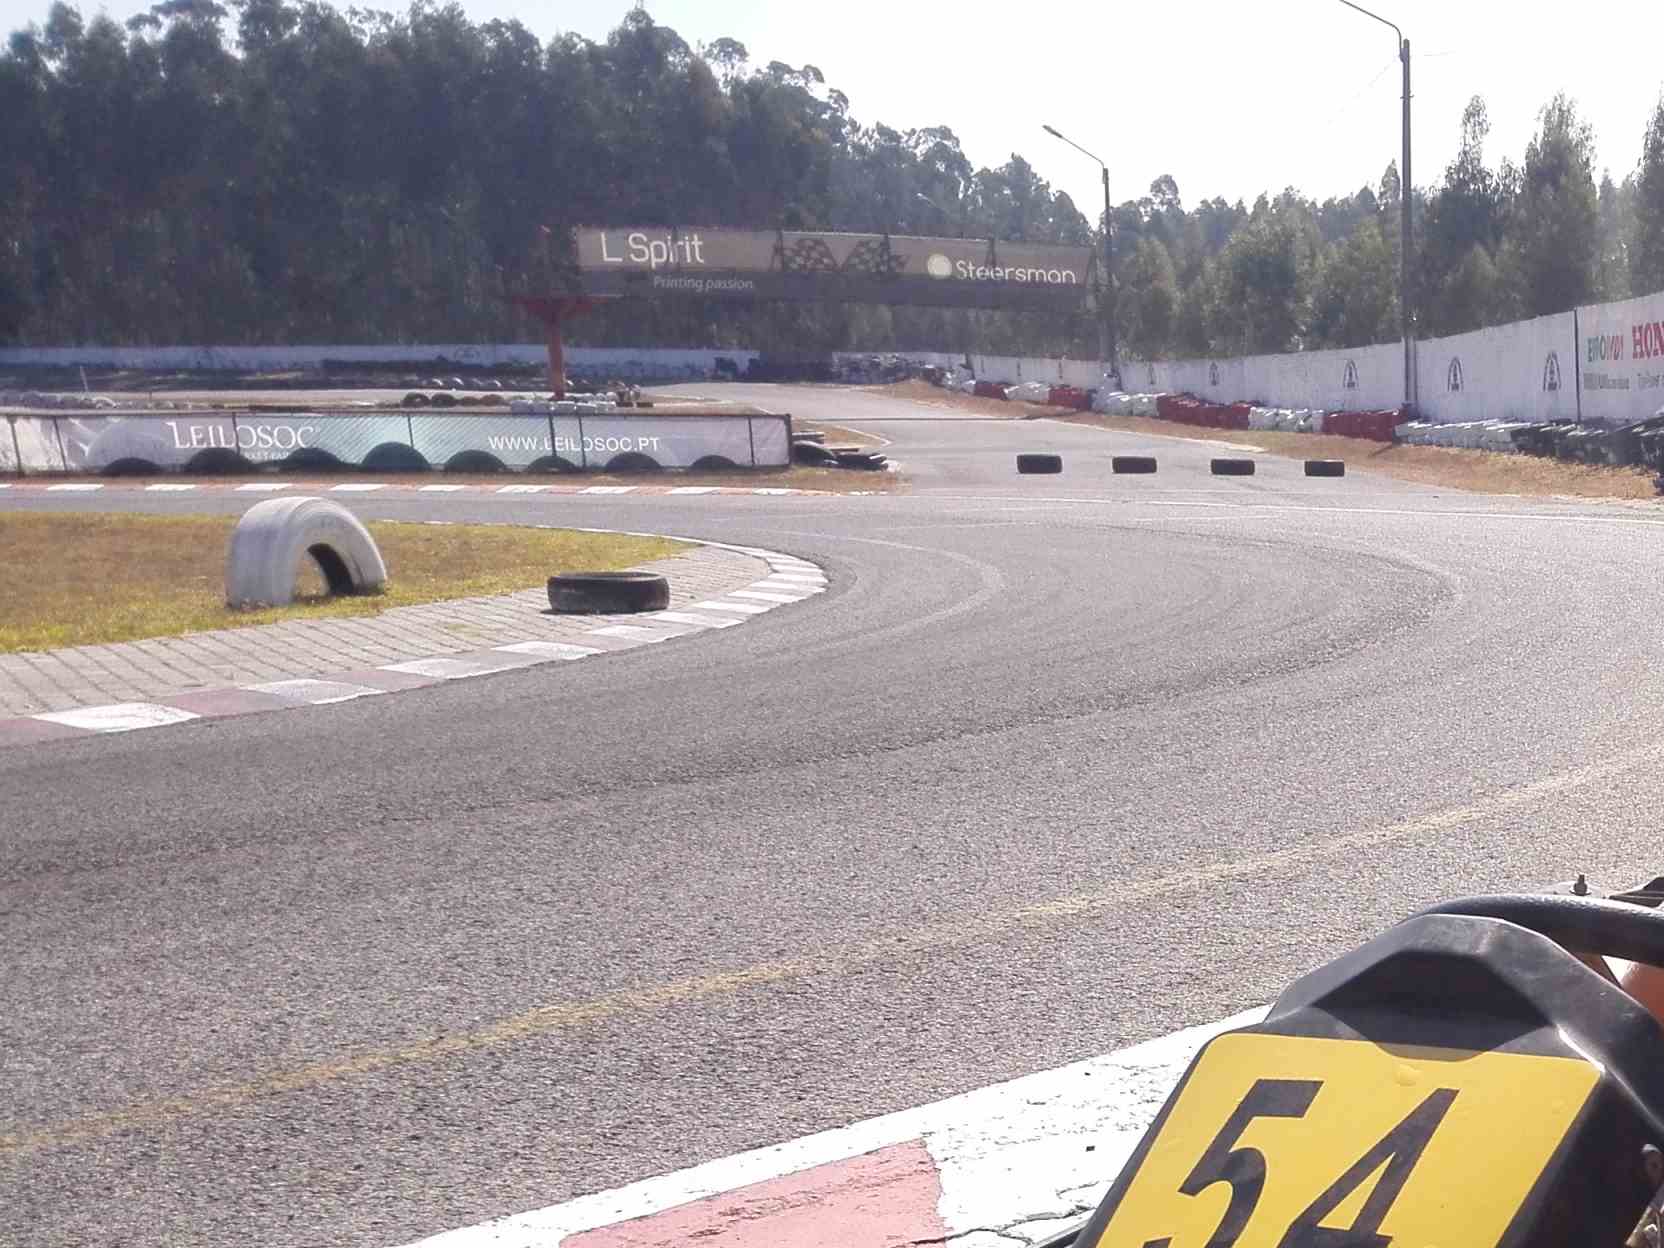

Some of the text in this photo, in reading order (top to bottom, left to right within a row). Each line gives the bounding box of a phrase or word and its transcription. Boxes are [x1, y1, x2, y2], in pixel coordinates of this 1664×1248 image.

[627, 232, 705, 269] Spirit
[955, 259, 1077, 285] Steersman
[165, 420, 315, 449] LEILOSOC
[488, 435, 661, 453] WWW.LEILOSOC.PT
